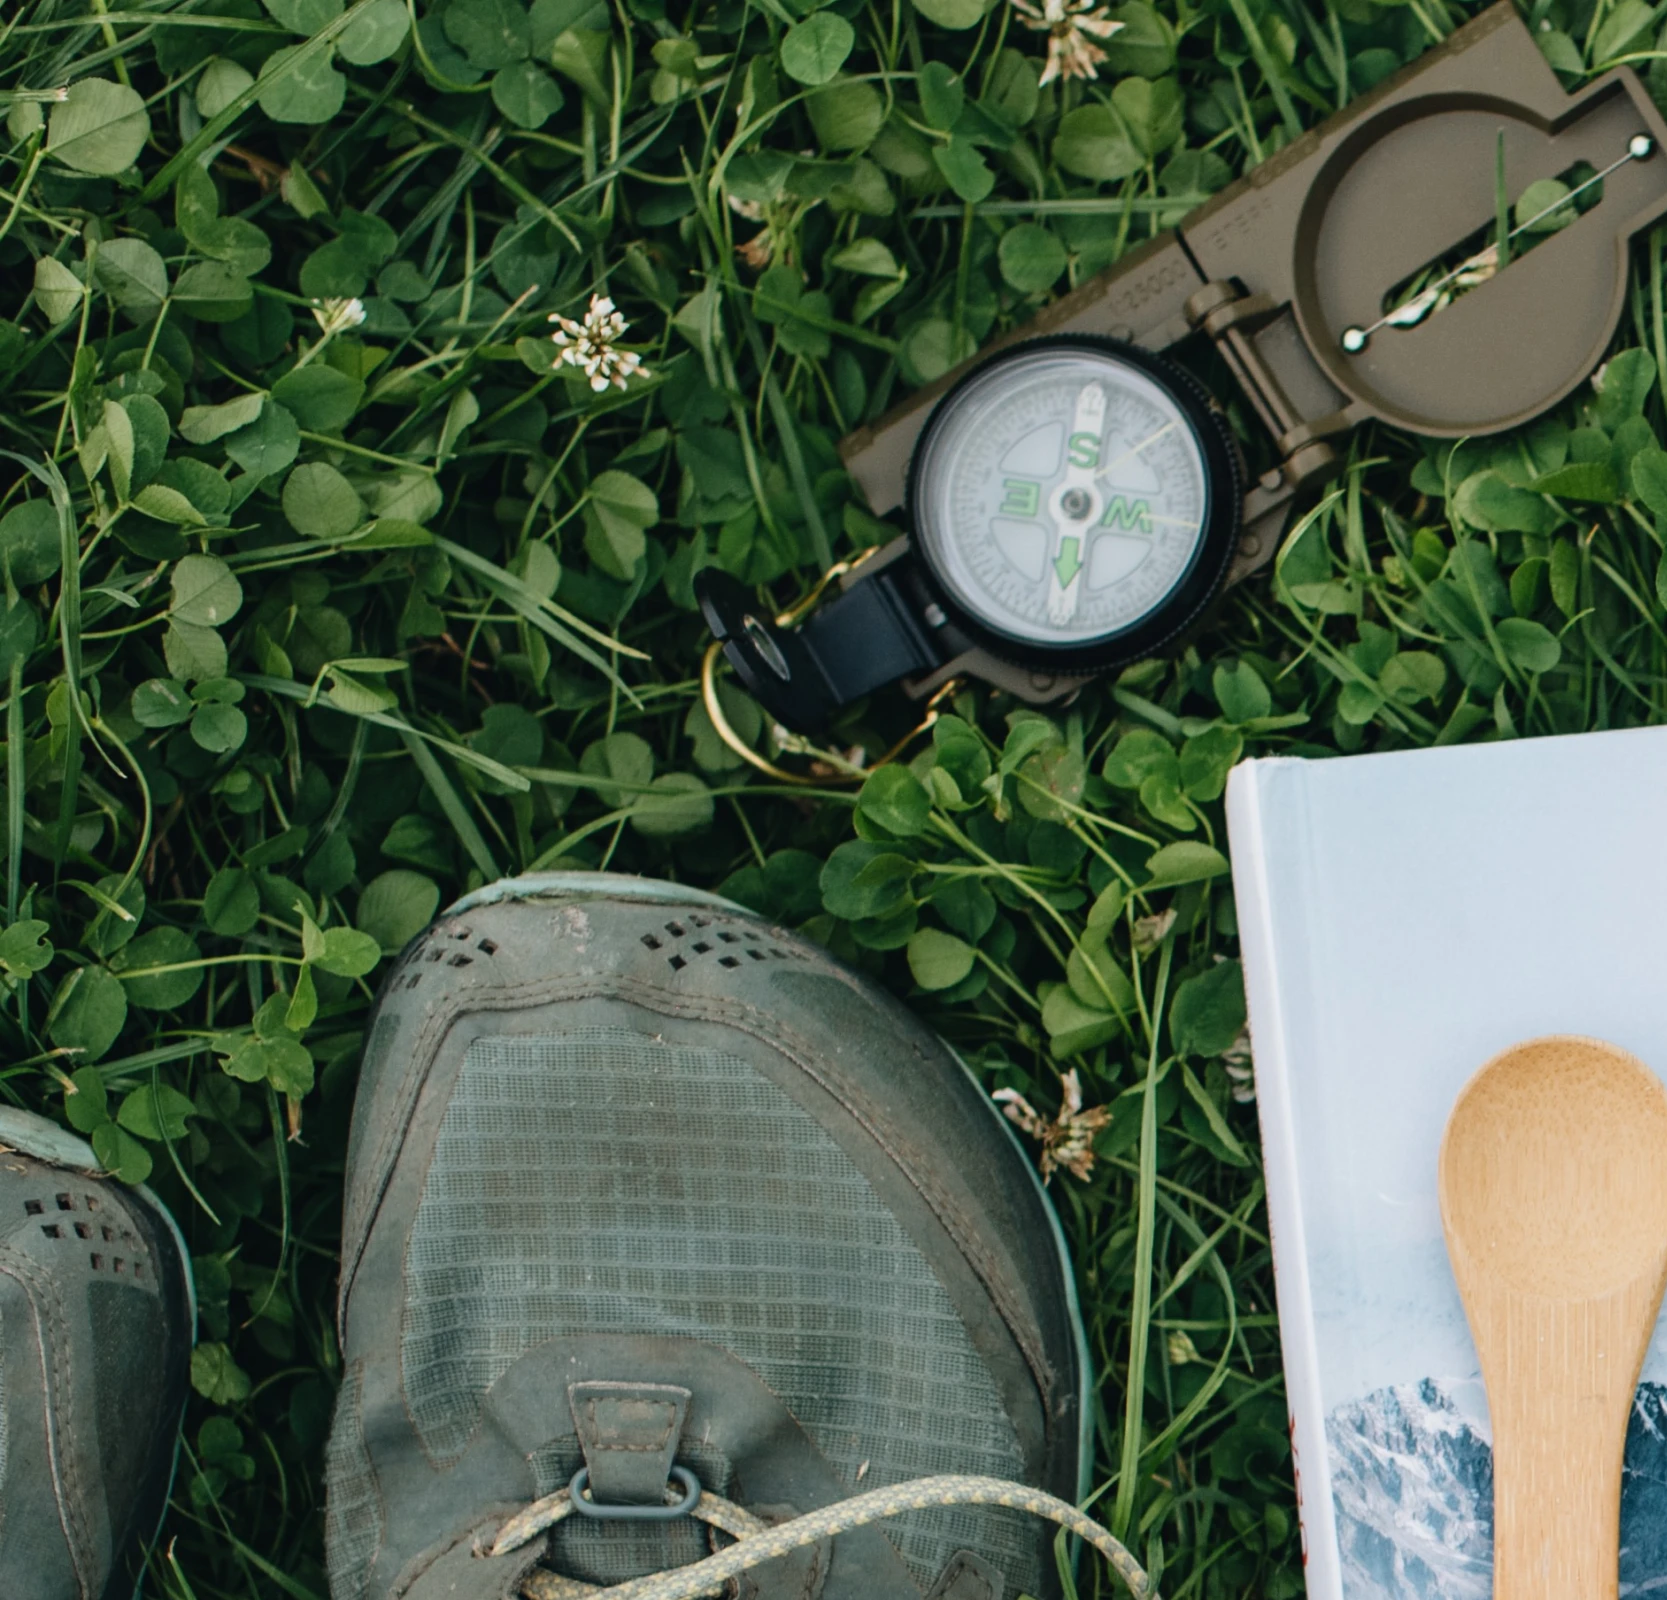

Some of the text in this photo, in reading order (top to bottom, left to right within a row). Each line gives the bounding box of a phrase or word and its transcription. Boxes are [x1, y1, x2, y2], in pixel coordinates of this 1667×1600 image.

[1068, 431, 1101, 469] S
[1000, 478, 1041, 517] E
[1101, 495, 1153, 534] W
